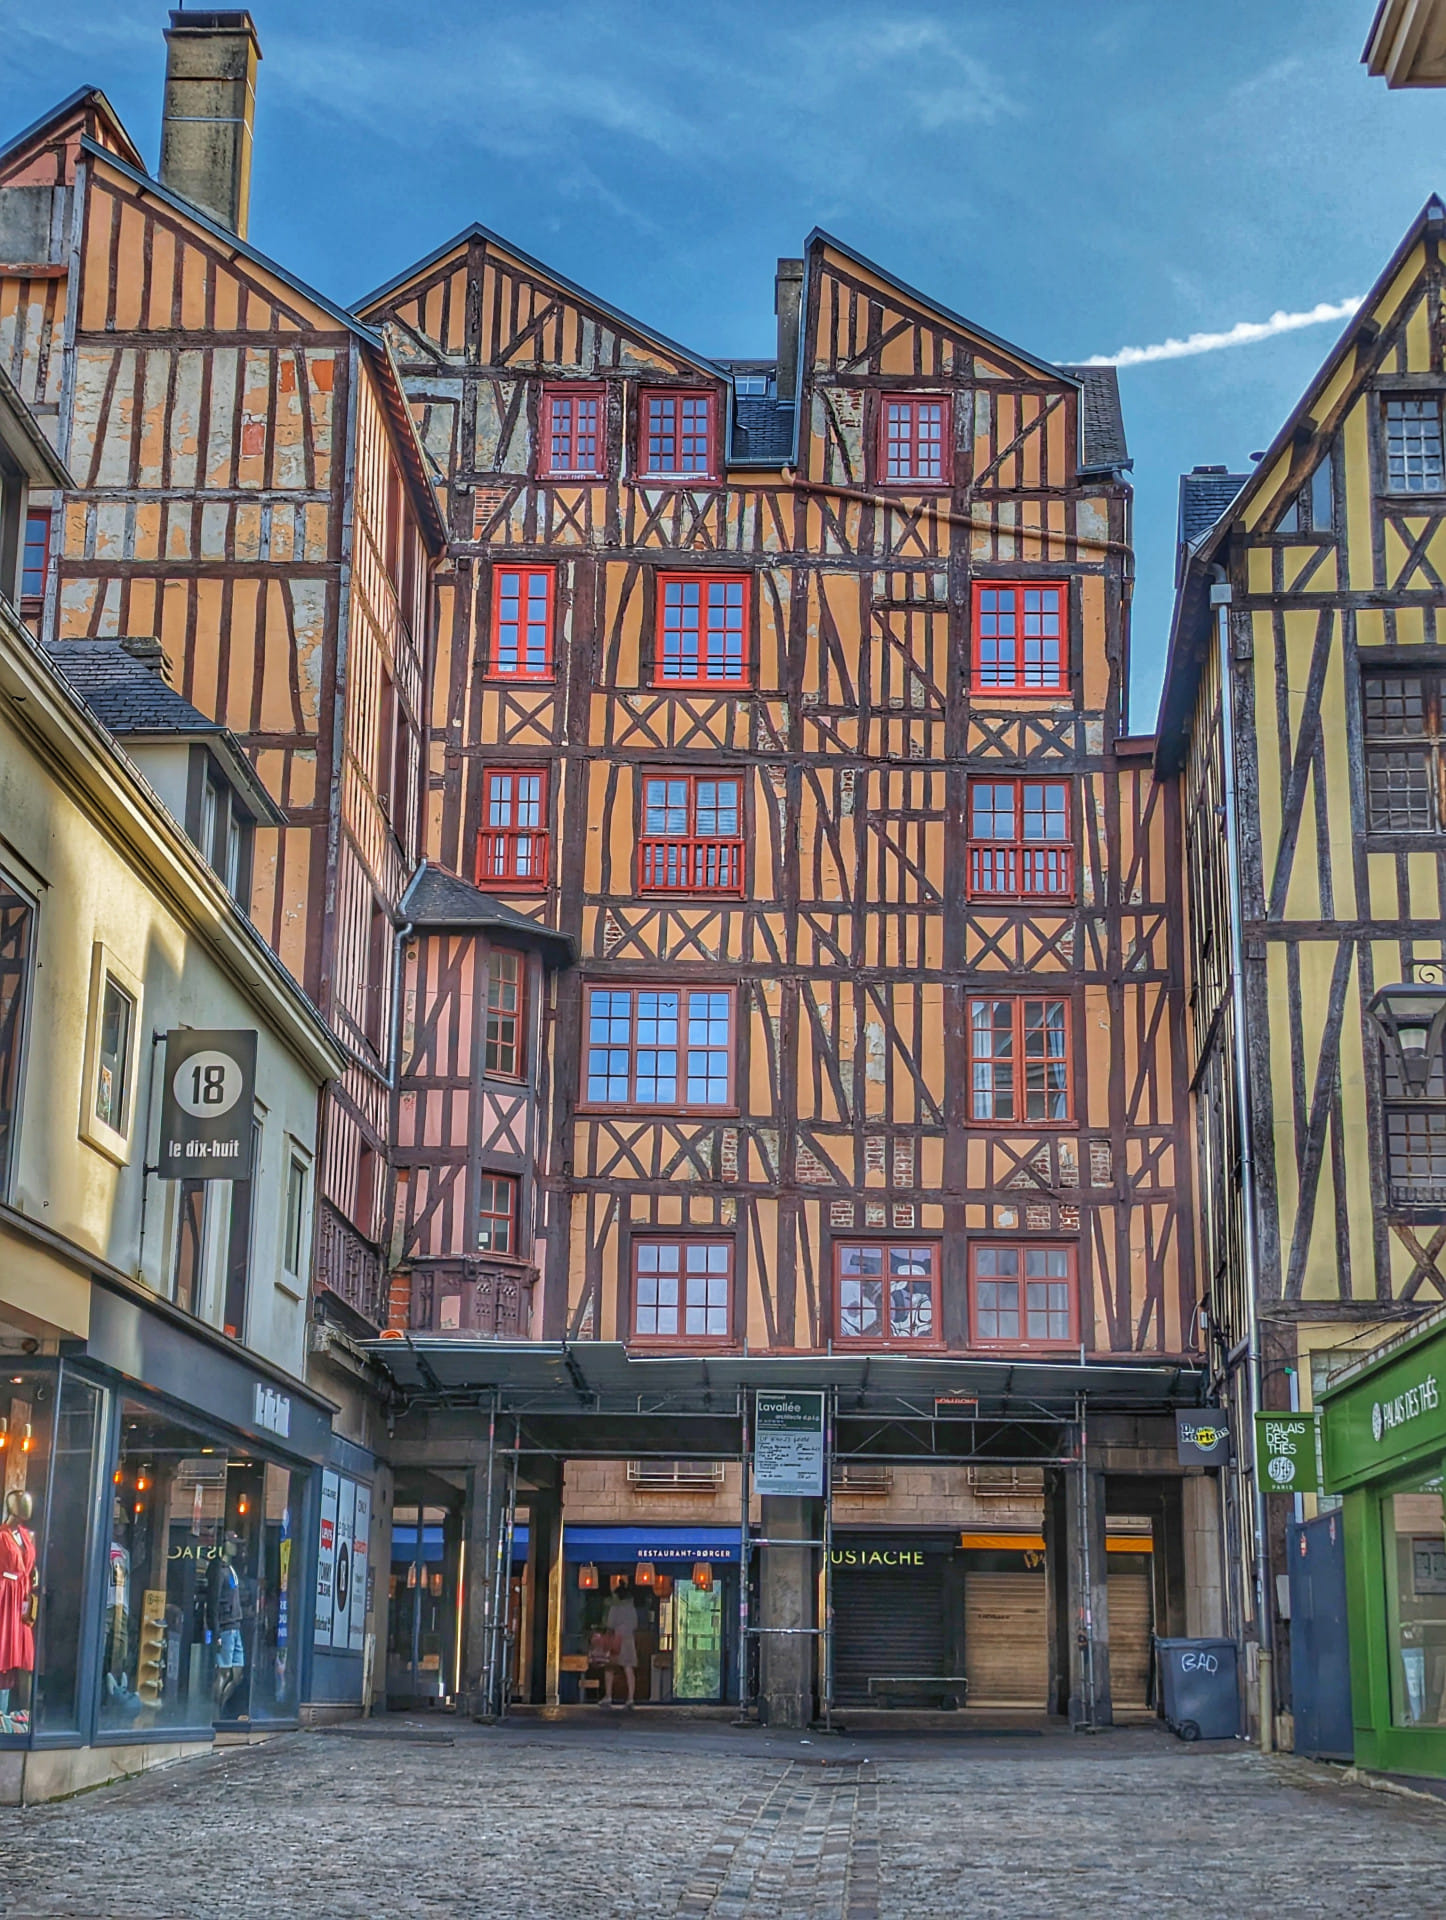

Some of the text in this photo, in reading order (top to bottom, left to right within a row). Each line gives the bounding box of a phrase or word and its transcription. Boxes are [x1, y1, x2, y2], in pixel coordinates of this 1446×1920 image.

[192, 1066, 225, 1105] 18
[168, 1140, 240, 1157] le dix-huit
[758, 1401, 802, 1413] Lavallée
[1383, 1374, 1439, 1431] PALAIS DES THÉS
[1265, 1422, 1305, 1434] PALAIS
[1266, 1433, 1289, 1444] DES
[824, 1550, 925, 1566] USTACHE
[1181, 1652, 1218, 1674] BAD
